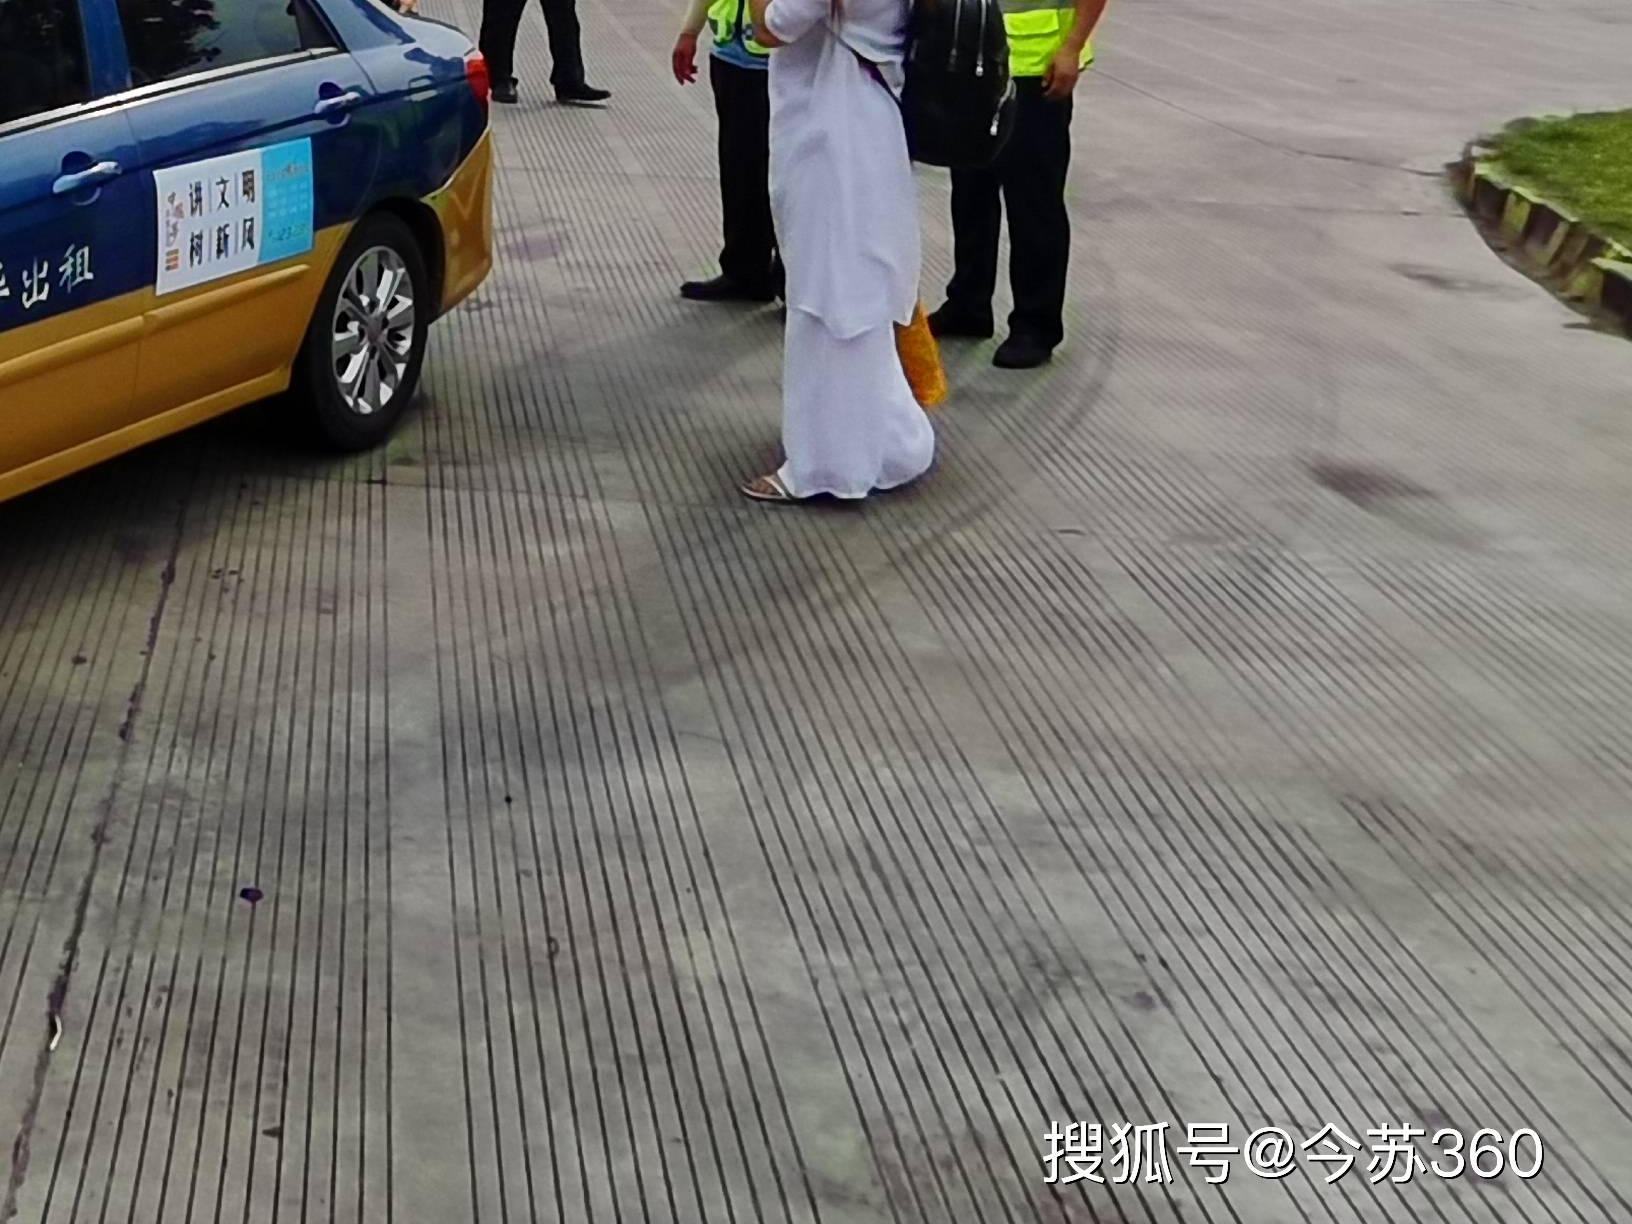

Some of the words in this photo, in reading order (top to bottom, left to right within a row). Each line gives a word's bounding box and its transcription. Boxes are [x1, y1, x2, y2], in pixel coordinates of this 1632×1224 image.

[188, 168, 256, 217] 讲文明
[188, 216, 256, 269] 树新风
